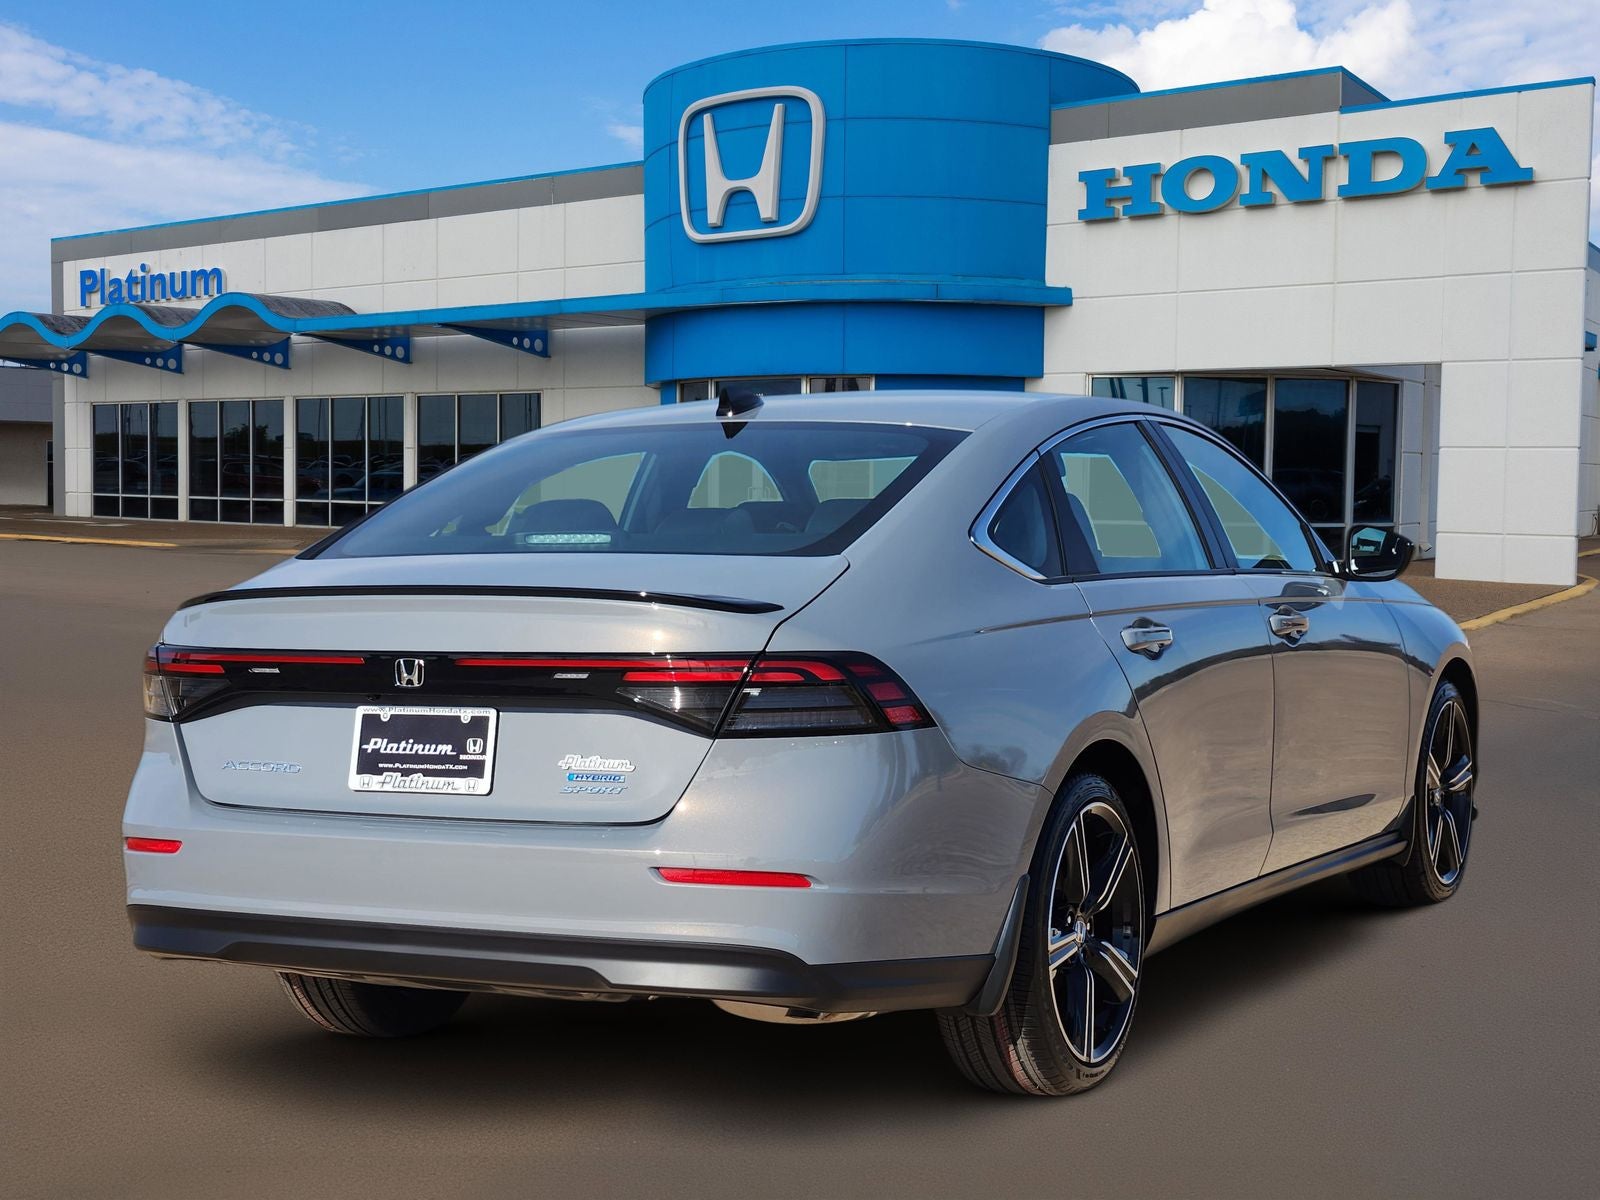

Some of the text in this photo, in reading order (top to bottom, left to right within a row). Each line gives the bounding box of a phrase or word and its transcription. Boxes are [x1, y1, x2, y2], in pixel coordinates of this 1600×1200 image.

[1078, 127, 1533, 220] HONDA
[80, 263, 224, 307] Platinum
[361, 738, 457, 755] Platinum
[222, 760, 301, 773] ACCORD
[557, 754, 636, 772] Platinum
[376, 773, 462, 790] Platinum
[560, 785, 628, 794] SPORT
